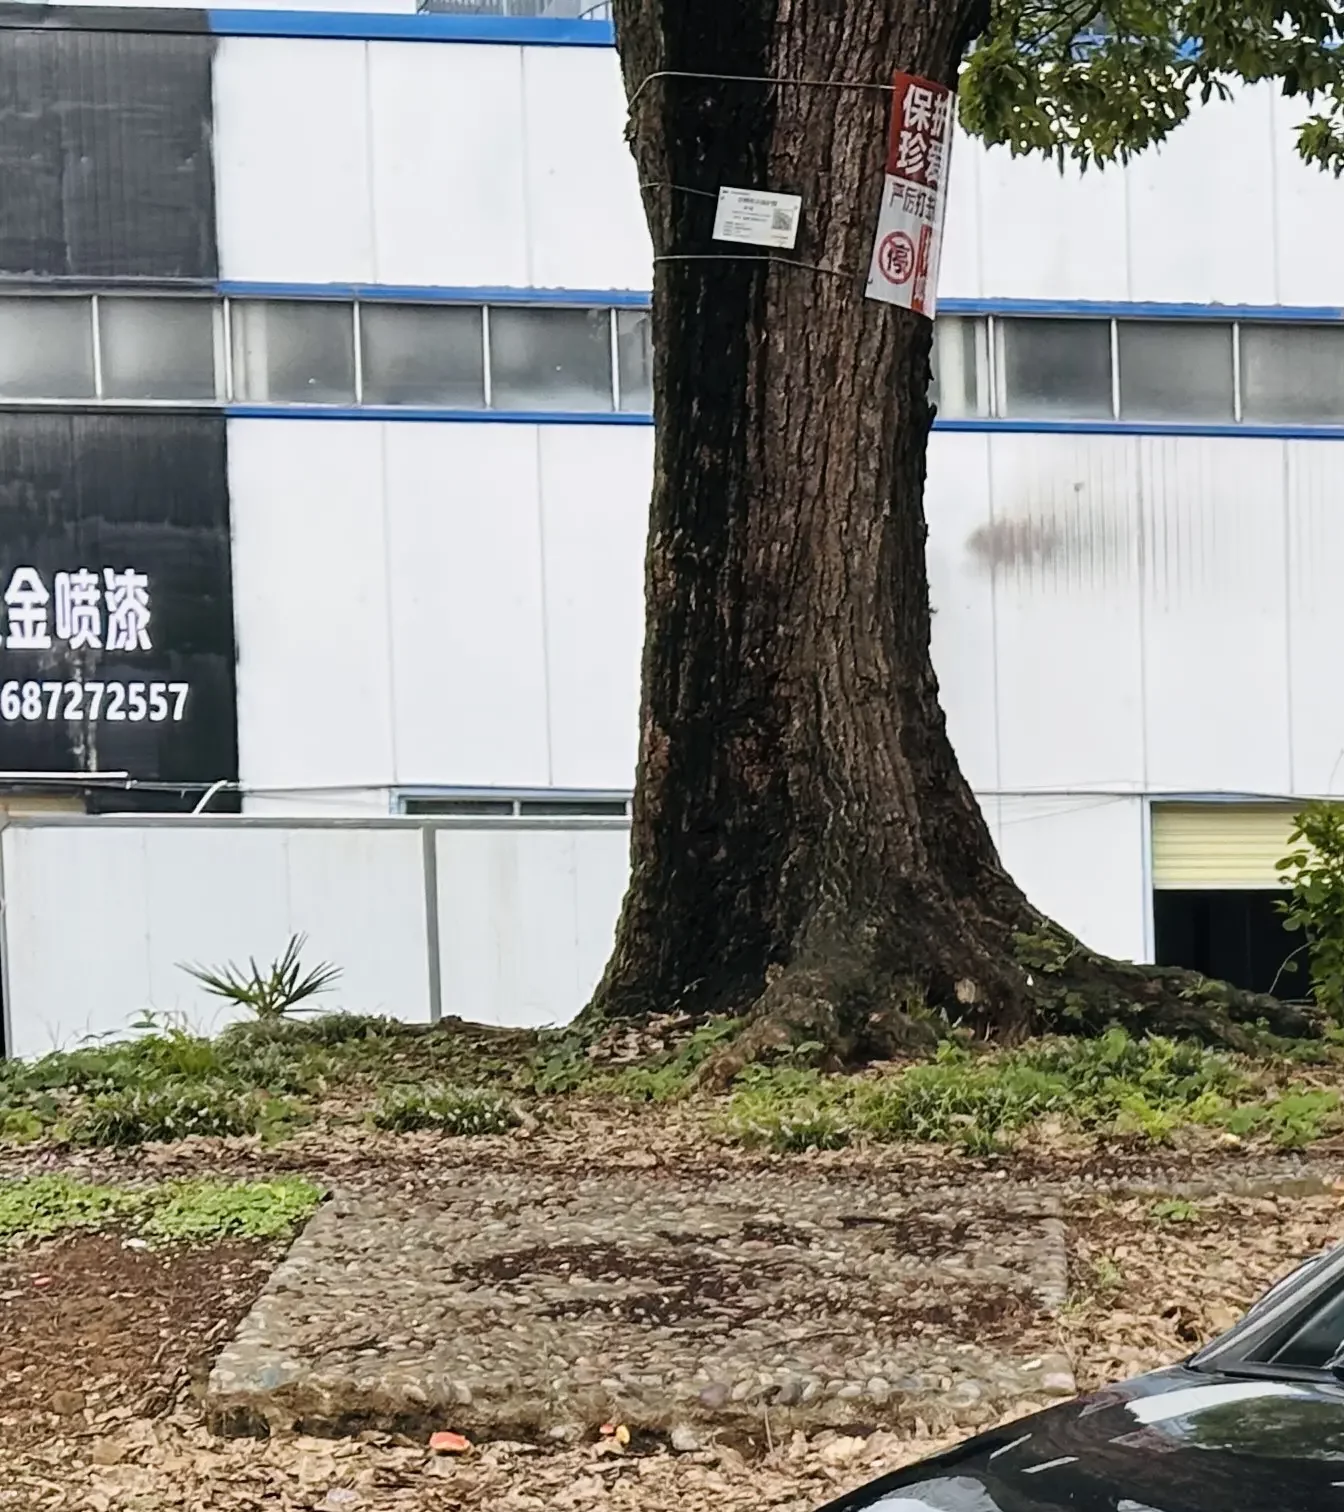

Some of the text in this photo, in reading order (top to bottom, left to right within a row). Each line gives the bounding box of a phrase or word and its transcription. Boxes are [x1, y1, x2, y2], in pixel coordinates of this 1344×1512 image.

[0, 567, 152, 650] 金喷漆
[0, 680, 189, 721] 687272557
